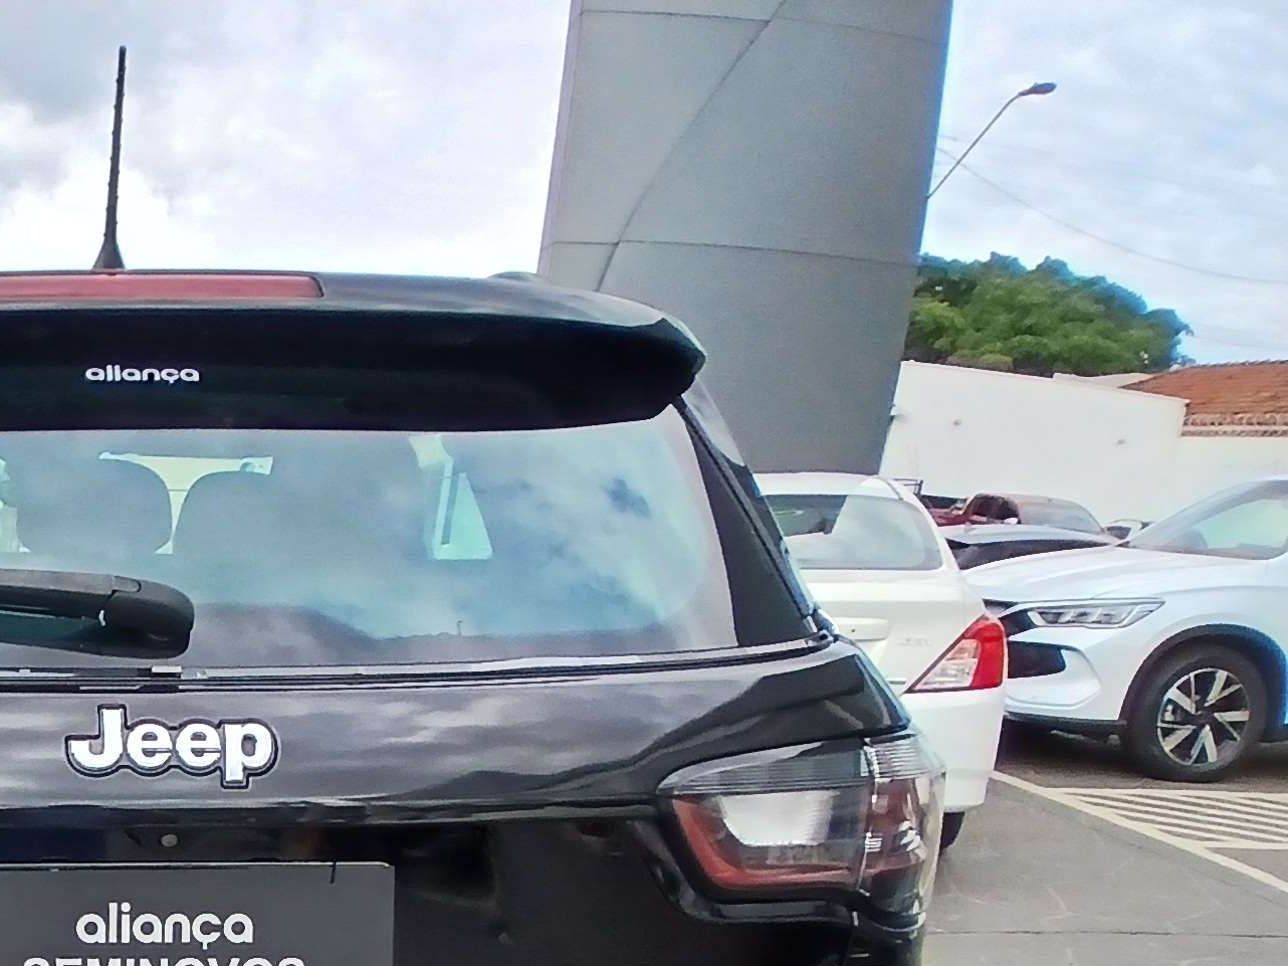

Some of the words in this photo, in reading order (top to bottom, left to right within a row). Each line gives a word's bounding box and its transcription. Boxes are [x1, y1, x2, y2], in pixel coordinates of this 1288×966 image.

[85, 364, 200, 384] aliança
[66, 704, 277, 787] Jeep
[75, 902, 254, 950] aliança
